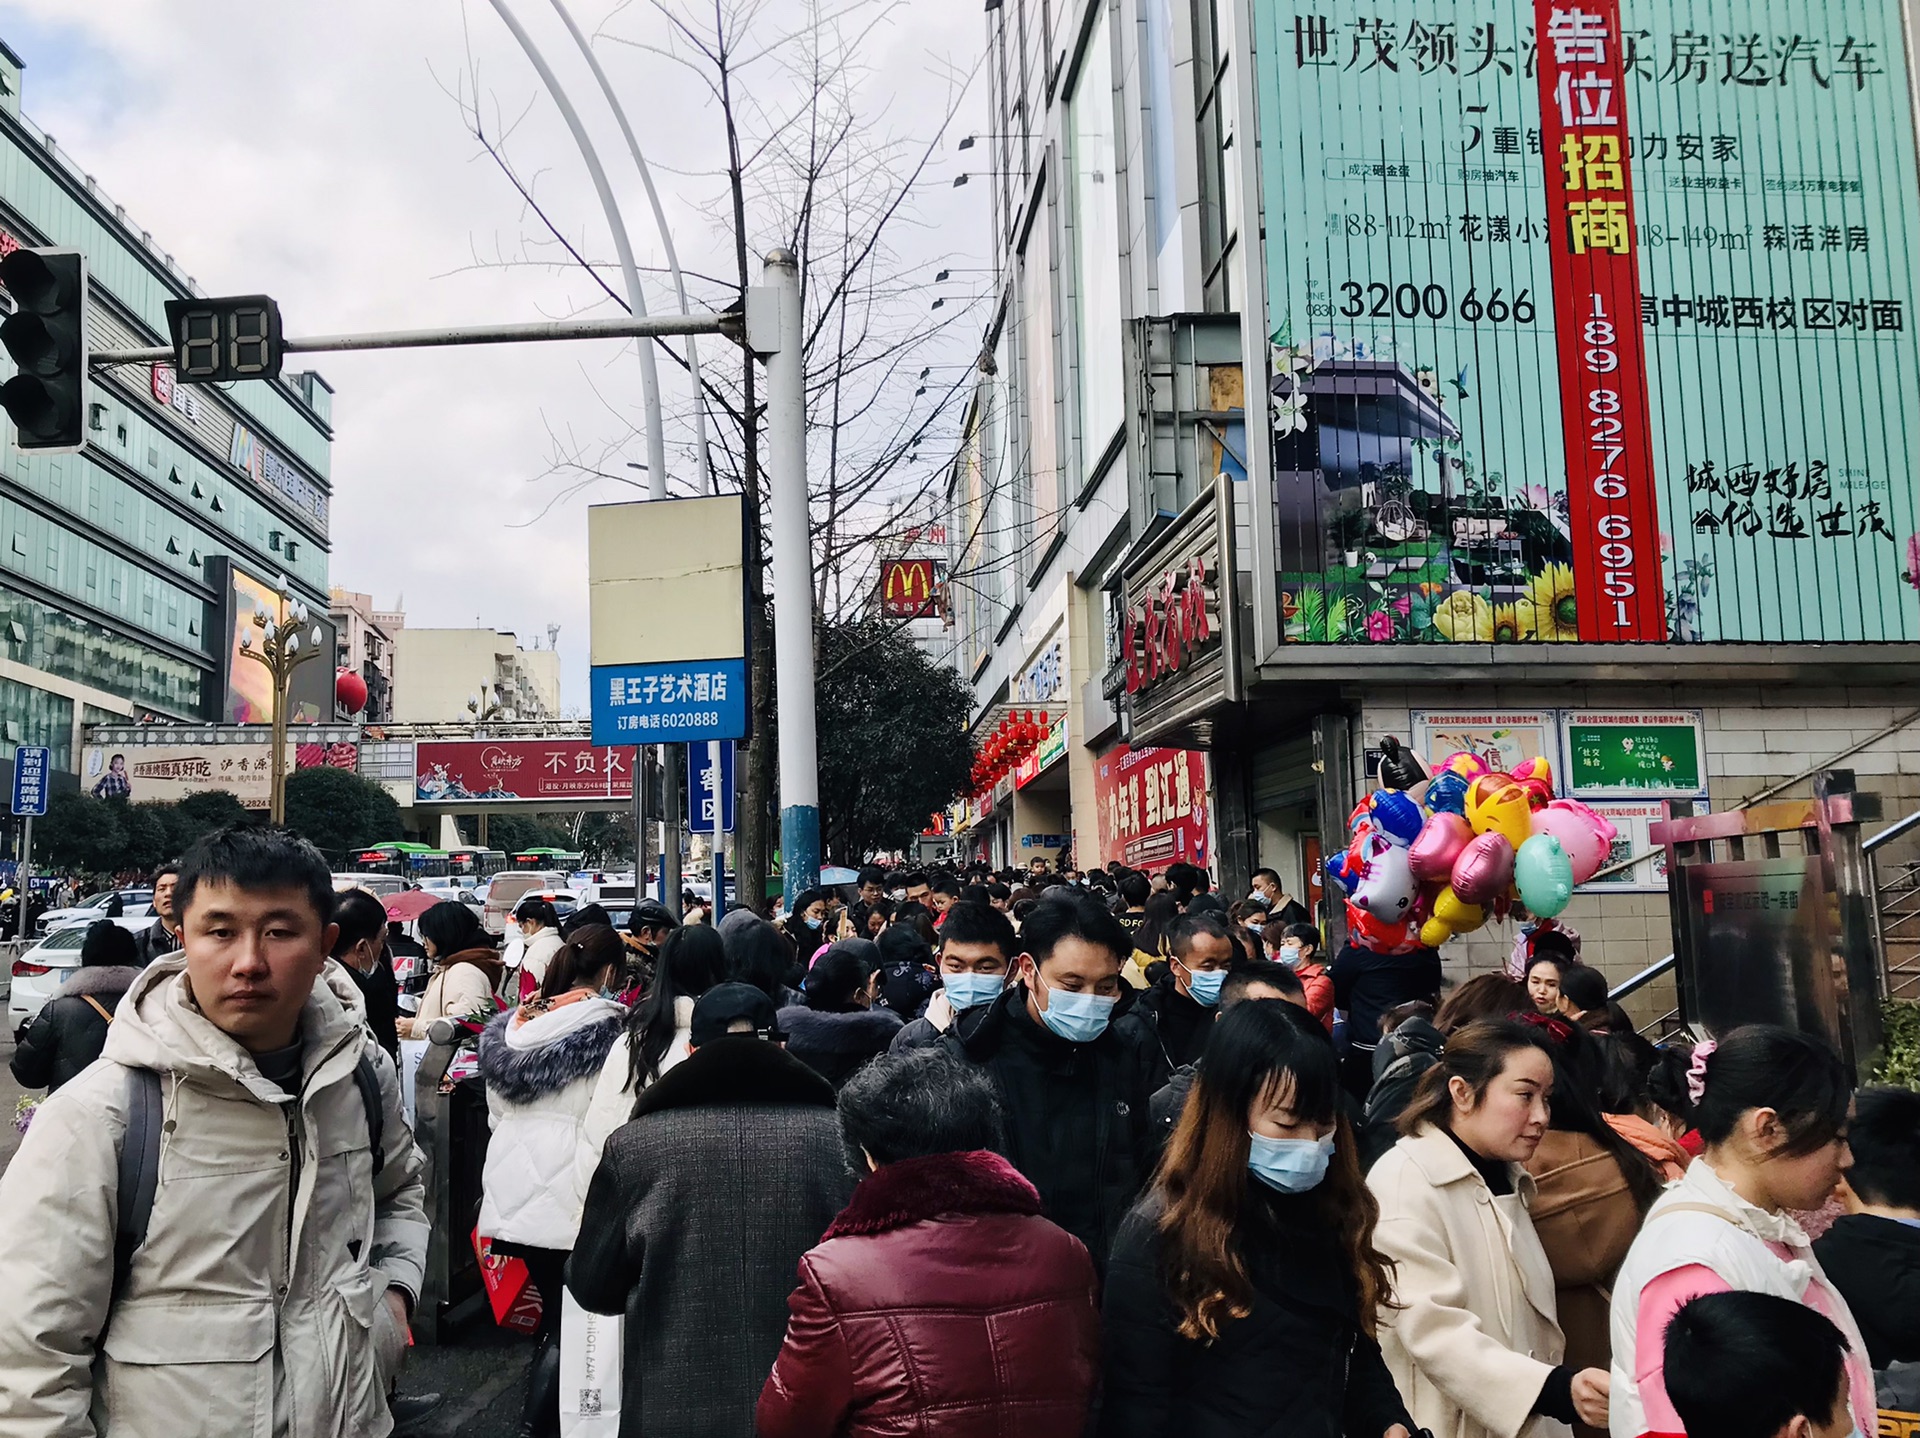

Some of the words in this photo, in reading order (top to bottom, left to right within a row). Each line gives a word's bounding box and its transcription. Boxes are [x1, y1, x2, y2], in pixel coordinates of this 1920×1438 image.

[1348, 164, 1411, 178] 成交砸金蛋
[1457, 168, 1520, 183] 购房抽汽车
[1668, 176, 1742, 189] 送业主权益卡
[1762, 223, 1870, 253] 森活洋房
[1306, 304, 1337, 318] 0830
[610, 671, 728, 707] 黑王子艺术酒店
